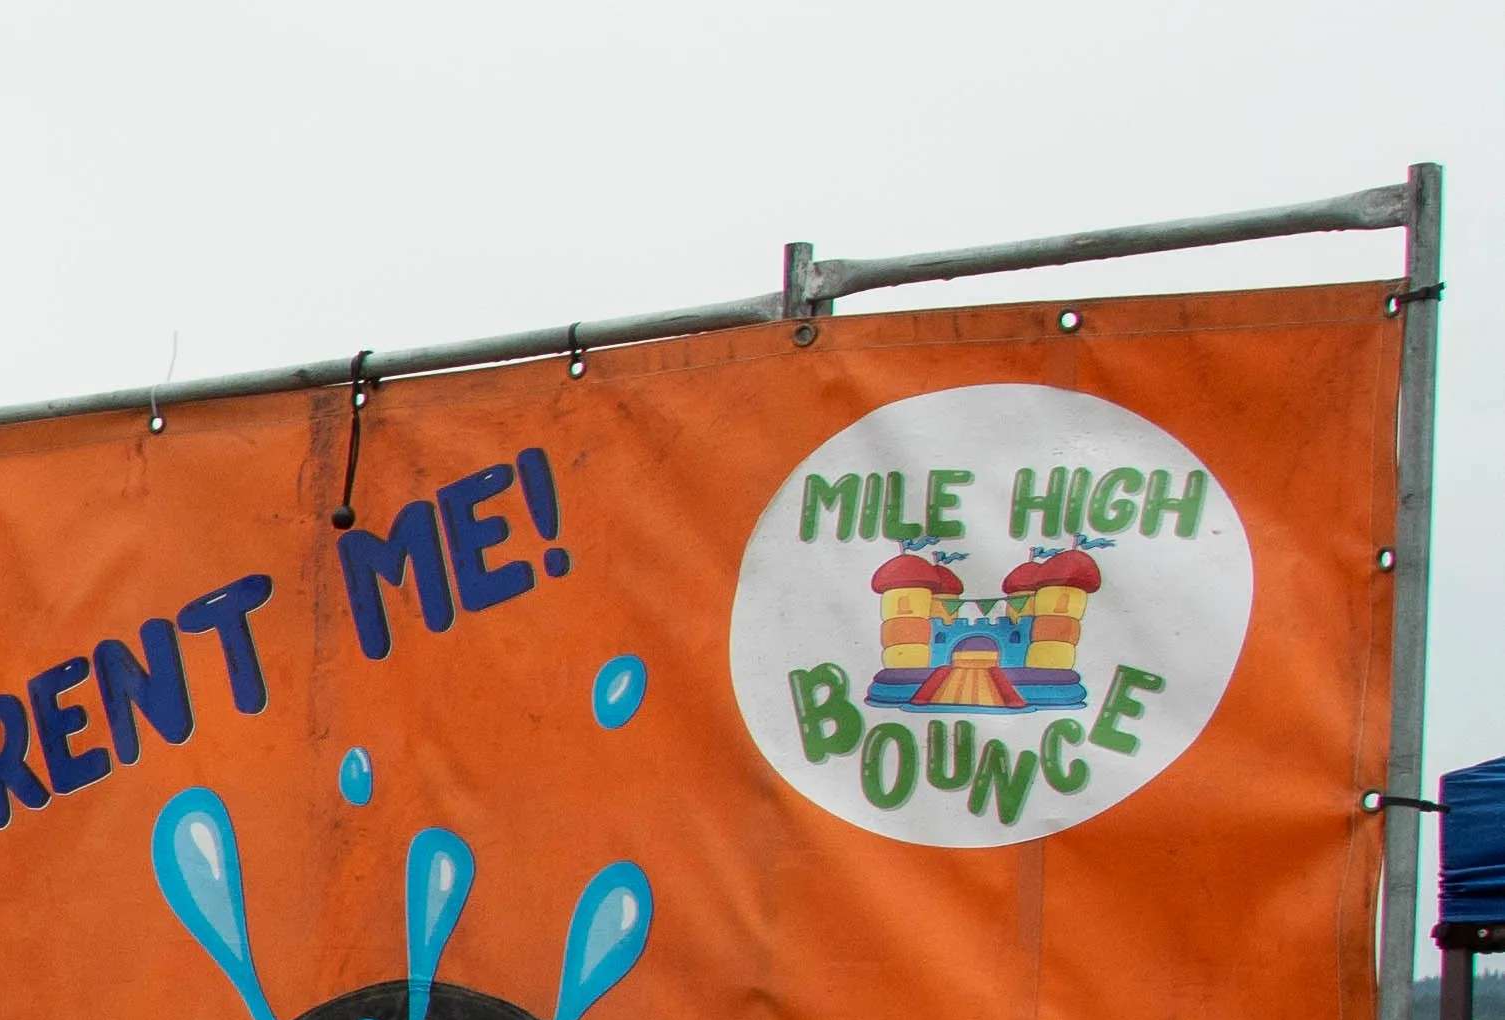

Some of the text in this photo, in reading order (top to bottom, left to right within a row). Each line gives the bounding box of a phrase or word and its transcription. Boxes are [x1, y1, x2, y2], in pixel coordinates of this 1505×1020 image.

[337, 447, 573, 661] ME!
[799, 466, 1209, 543] MILE HIGH
[788, 661, 1166, 826] BOUNCE
